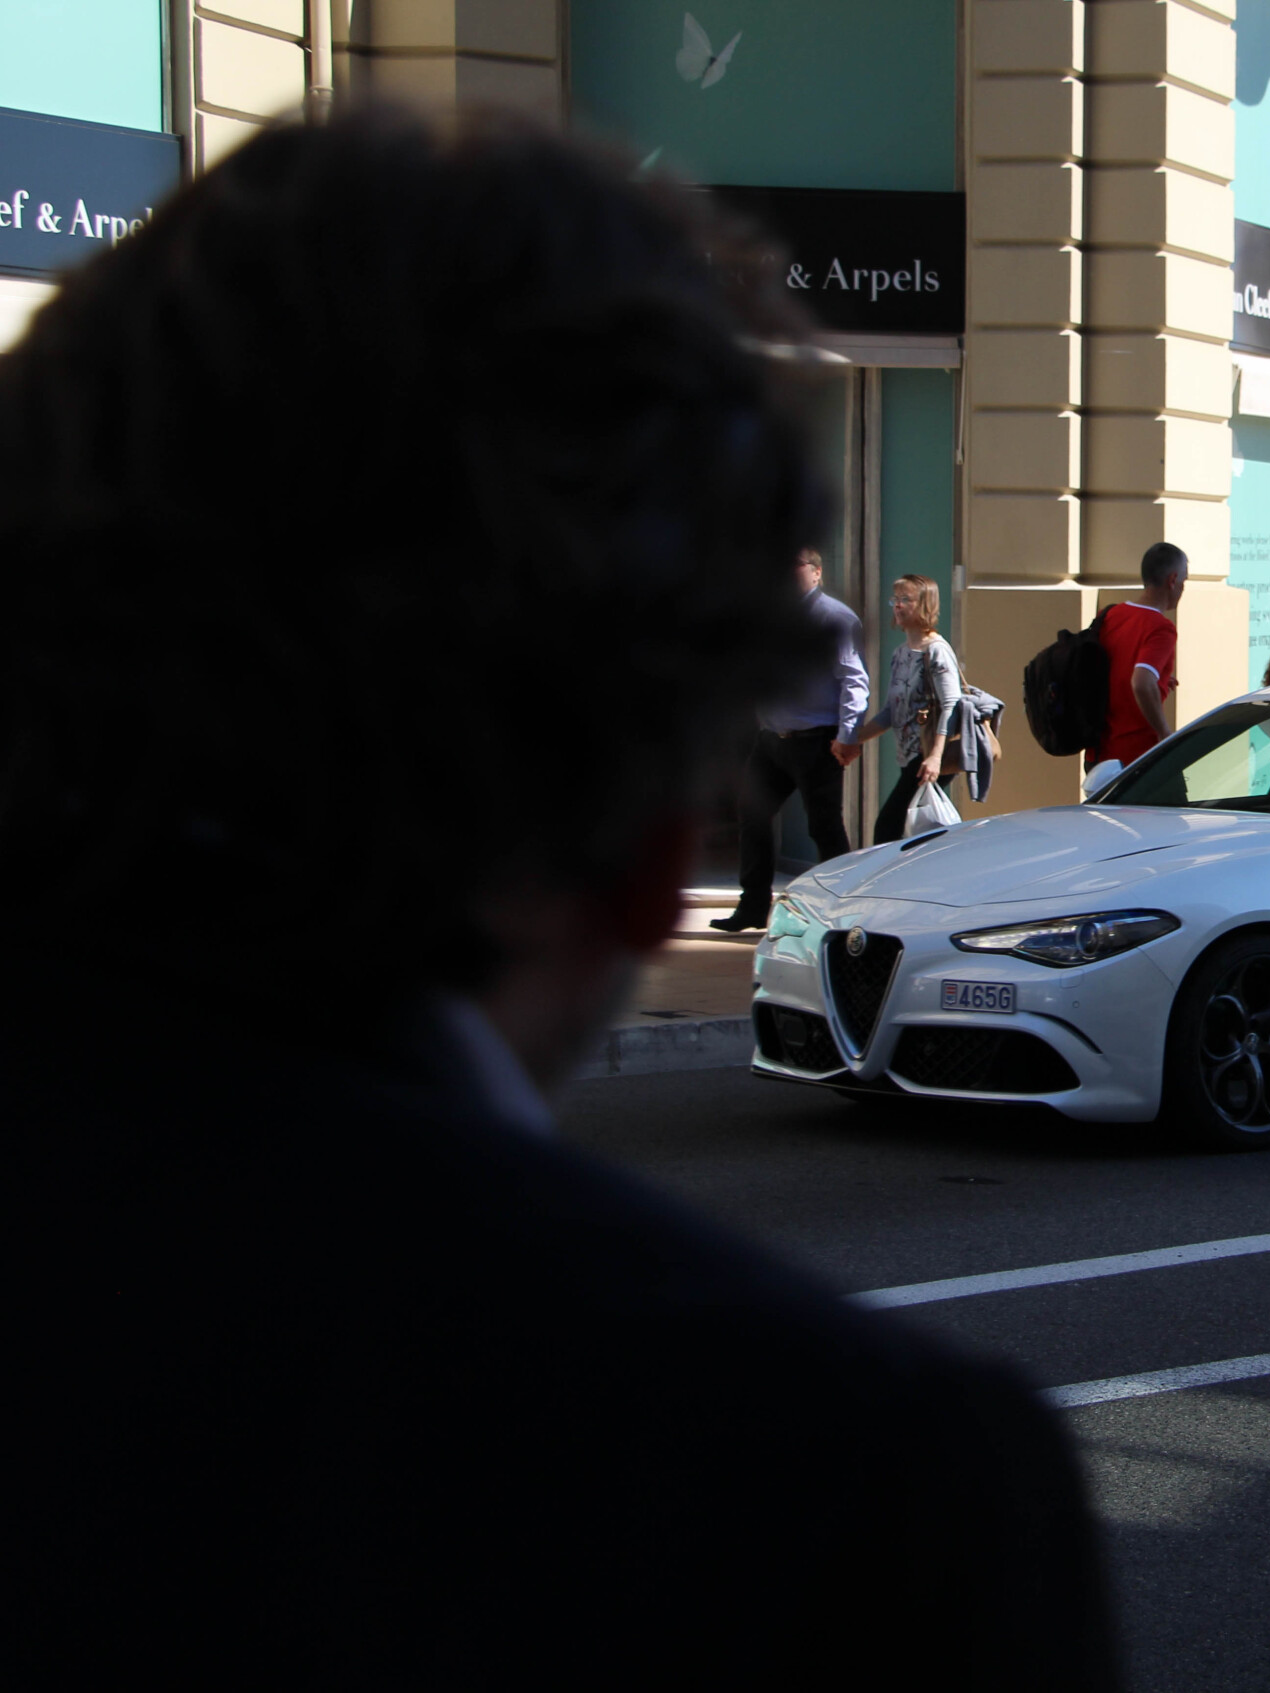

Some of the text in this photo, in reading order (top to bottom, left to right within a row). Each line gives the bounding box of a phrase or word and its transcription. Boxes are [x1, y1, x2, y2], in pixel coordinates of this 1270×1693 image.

[36, 202, 62, 234] &
[786, 263, 811, 289] &
[821, 257, 940, 302] Arpels
[959, 984, 1011, 1009] 465G
